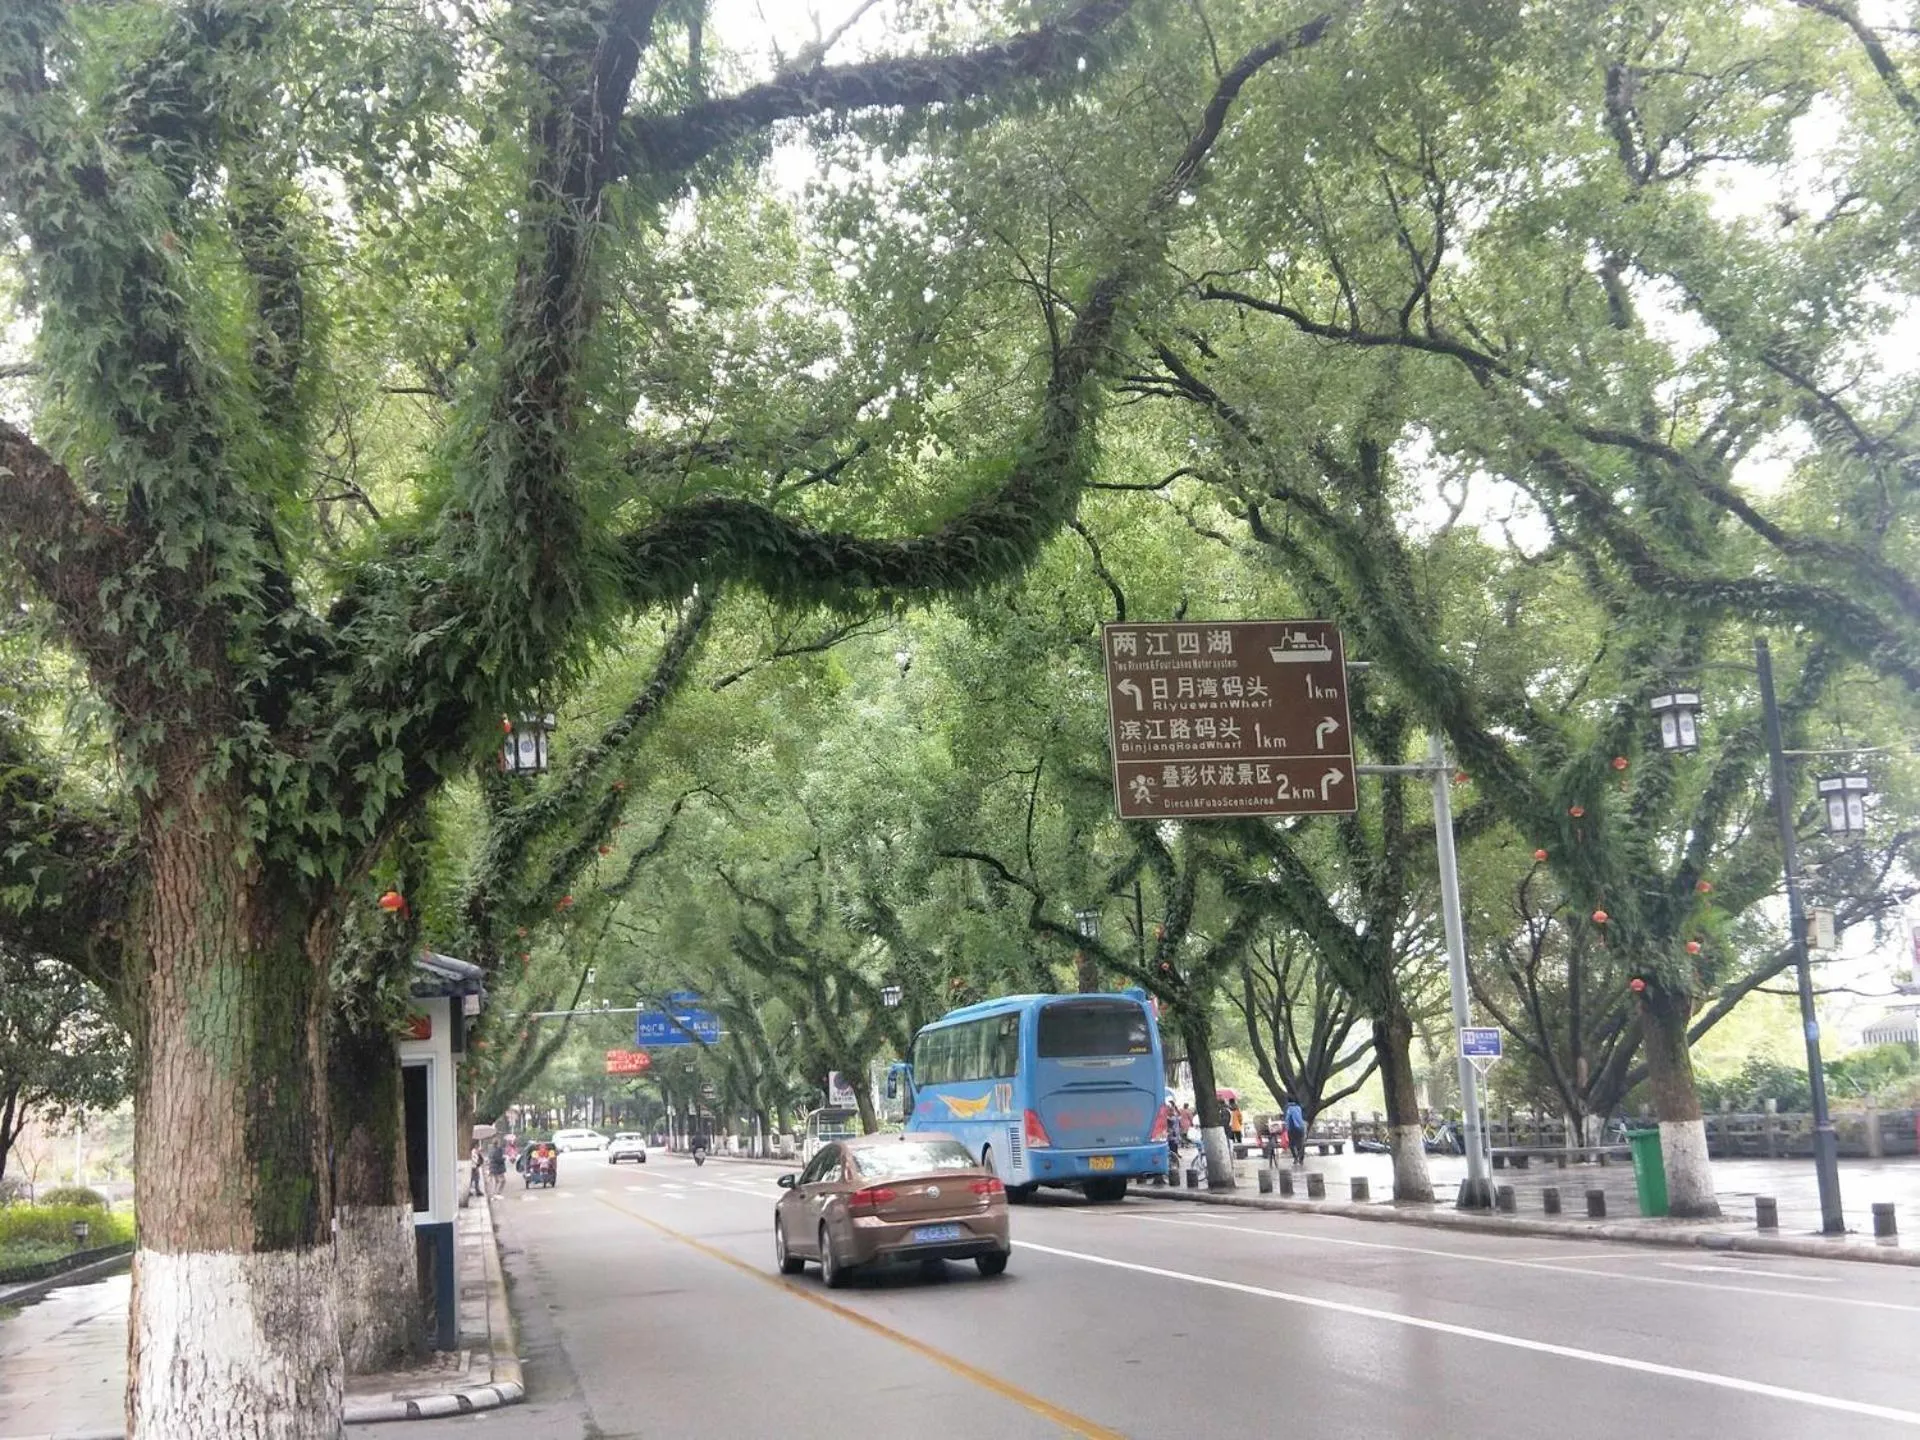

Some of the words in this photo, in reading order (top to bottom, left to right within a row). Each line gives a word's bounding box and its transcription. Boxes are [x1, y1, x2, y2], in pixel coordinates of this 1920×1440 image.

[1111, 630, 1233, 657] 两江四湖
[1151, 676, 1269, 700] 日月湾码头
[1305, 673, 1338, 699] 1km
[1119, 717, 1241, 741] 滨江路码头
[1254, 722, 1287, 749] 1km
[1162, 763, 1273, 788] 叠彩伏波景区
[1276, 774, 1316, 800] 2km
